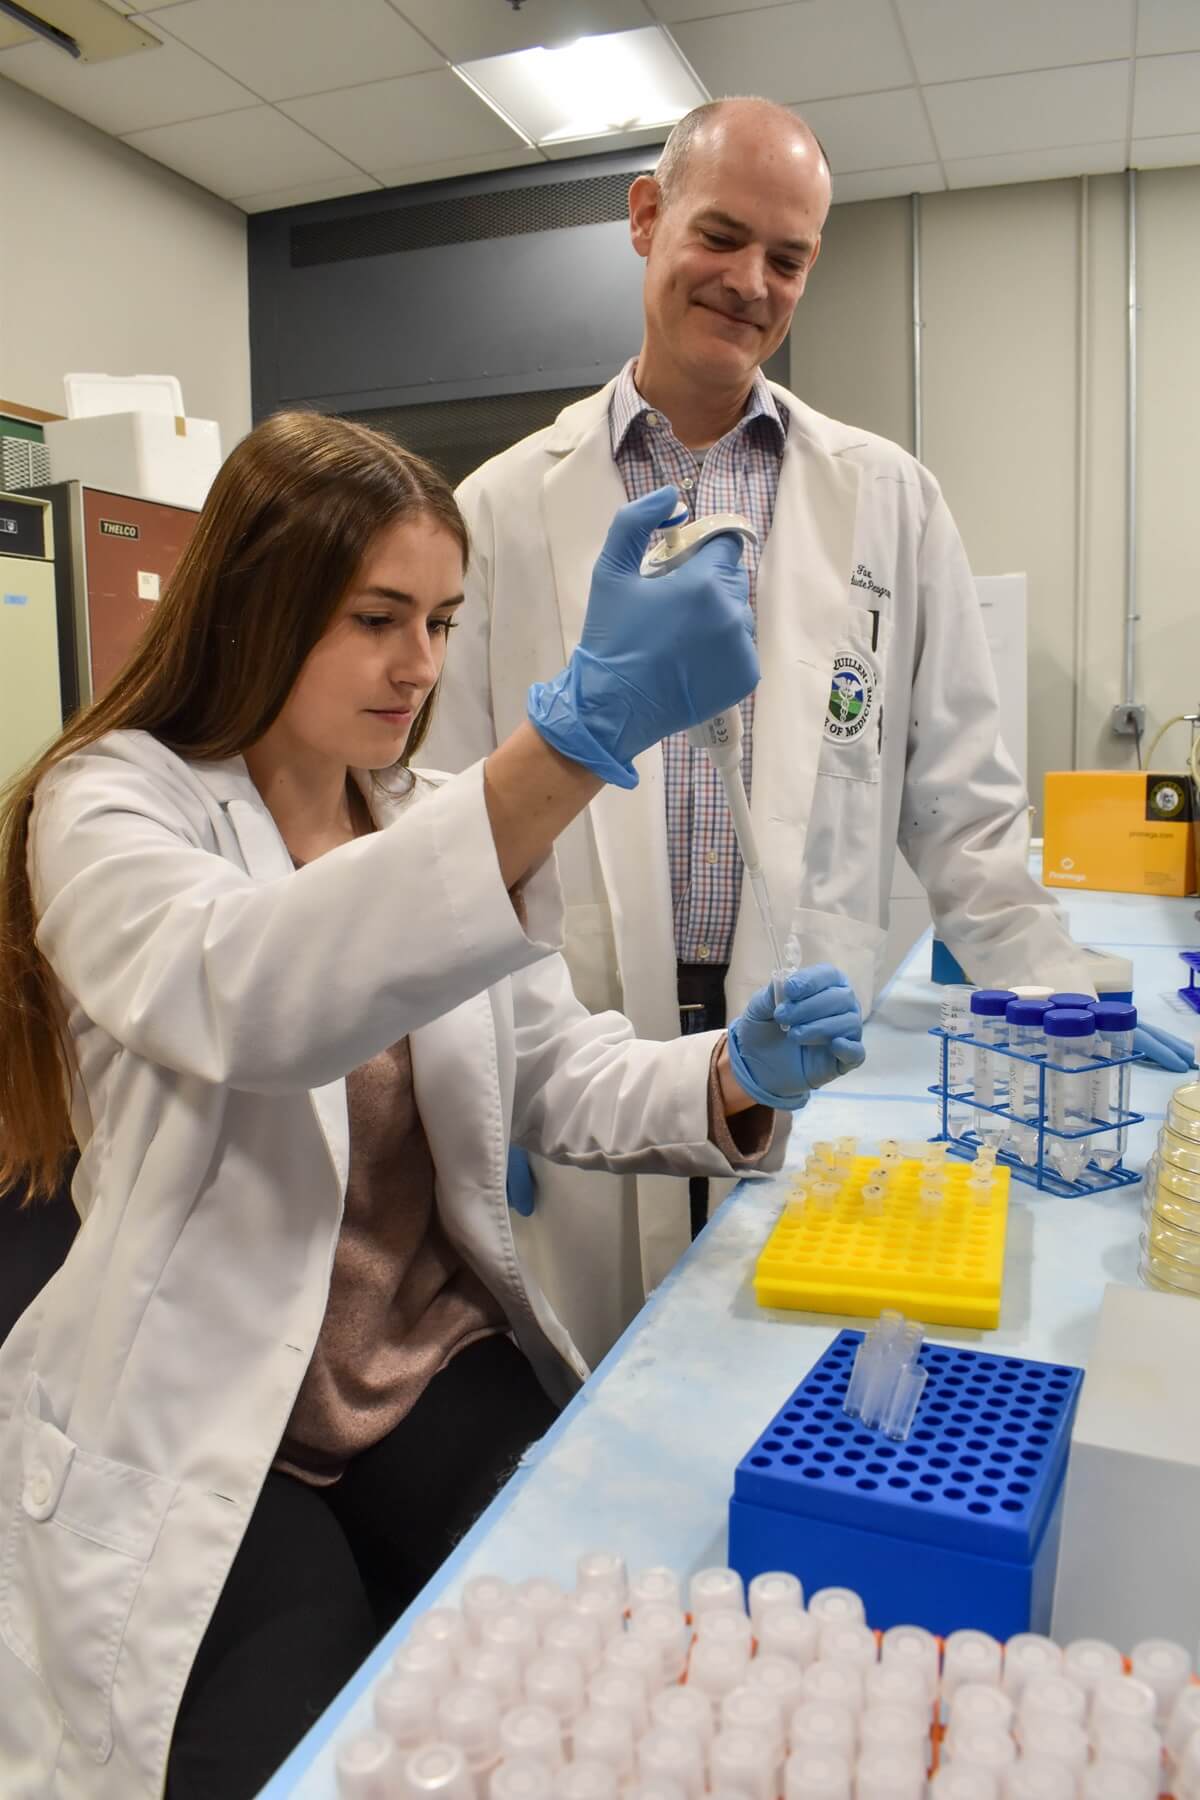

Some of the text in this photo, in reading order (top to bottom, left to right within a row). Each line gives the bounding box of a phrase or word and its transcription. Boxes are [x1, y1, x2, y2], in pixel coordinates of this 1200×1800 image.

[103, 522, 136, 537] THELCO
[829, 686, 873, 737] OF MEDICINE
